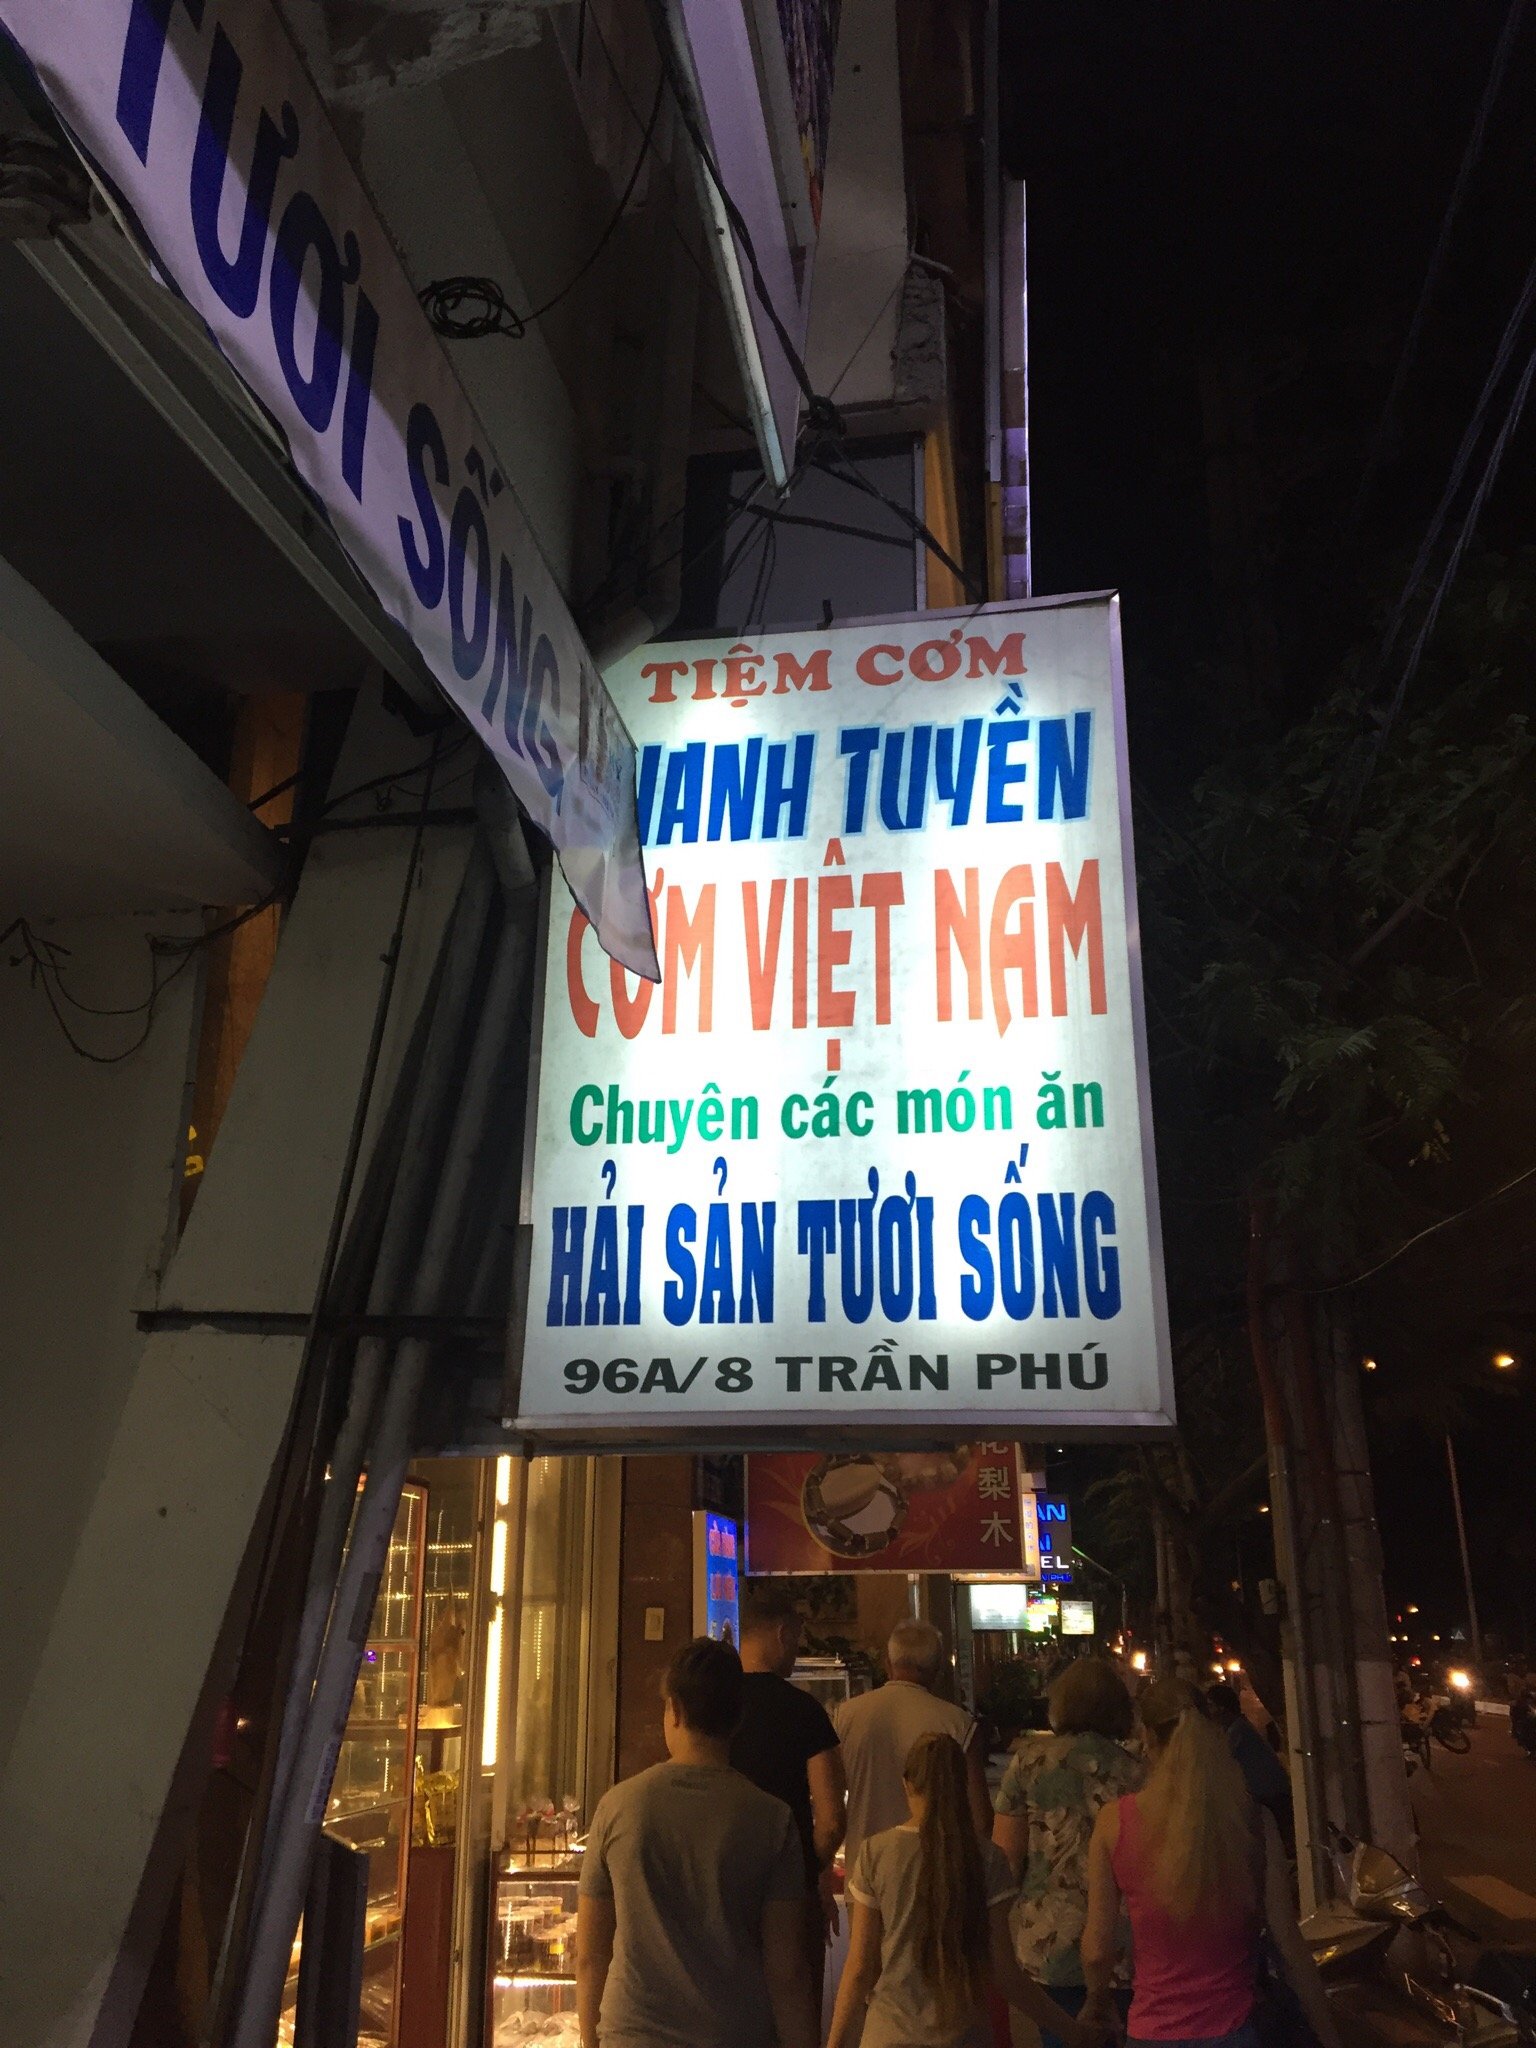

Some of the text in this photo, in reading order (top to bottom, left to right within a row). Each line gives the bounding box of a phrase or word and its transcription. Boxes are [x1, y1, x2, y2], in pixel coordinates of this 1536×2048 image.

[397, 402, 564, 816] SỐNG
[641, 629, 1028, 708] TIỆM CƠM
[840, 682, 1092, 833] TUYỀN
[742, 838, 905, 1072] VIỆT
[935, 859, 1108, 1038] NAM
[570, 1070, 1104, 1154] Chuyên các món ăn
[546, 1143, 1122, 1327] HẢI SẢN TƯƠI SỐNG
[563, 1338, 1108, 1394] 96A/8 TRẦN PHÚ
